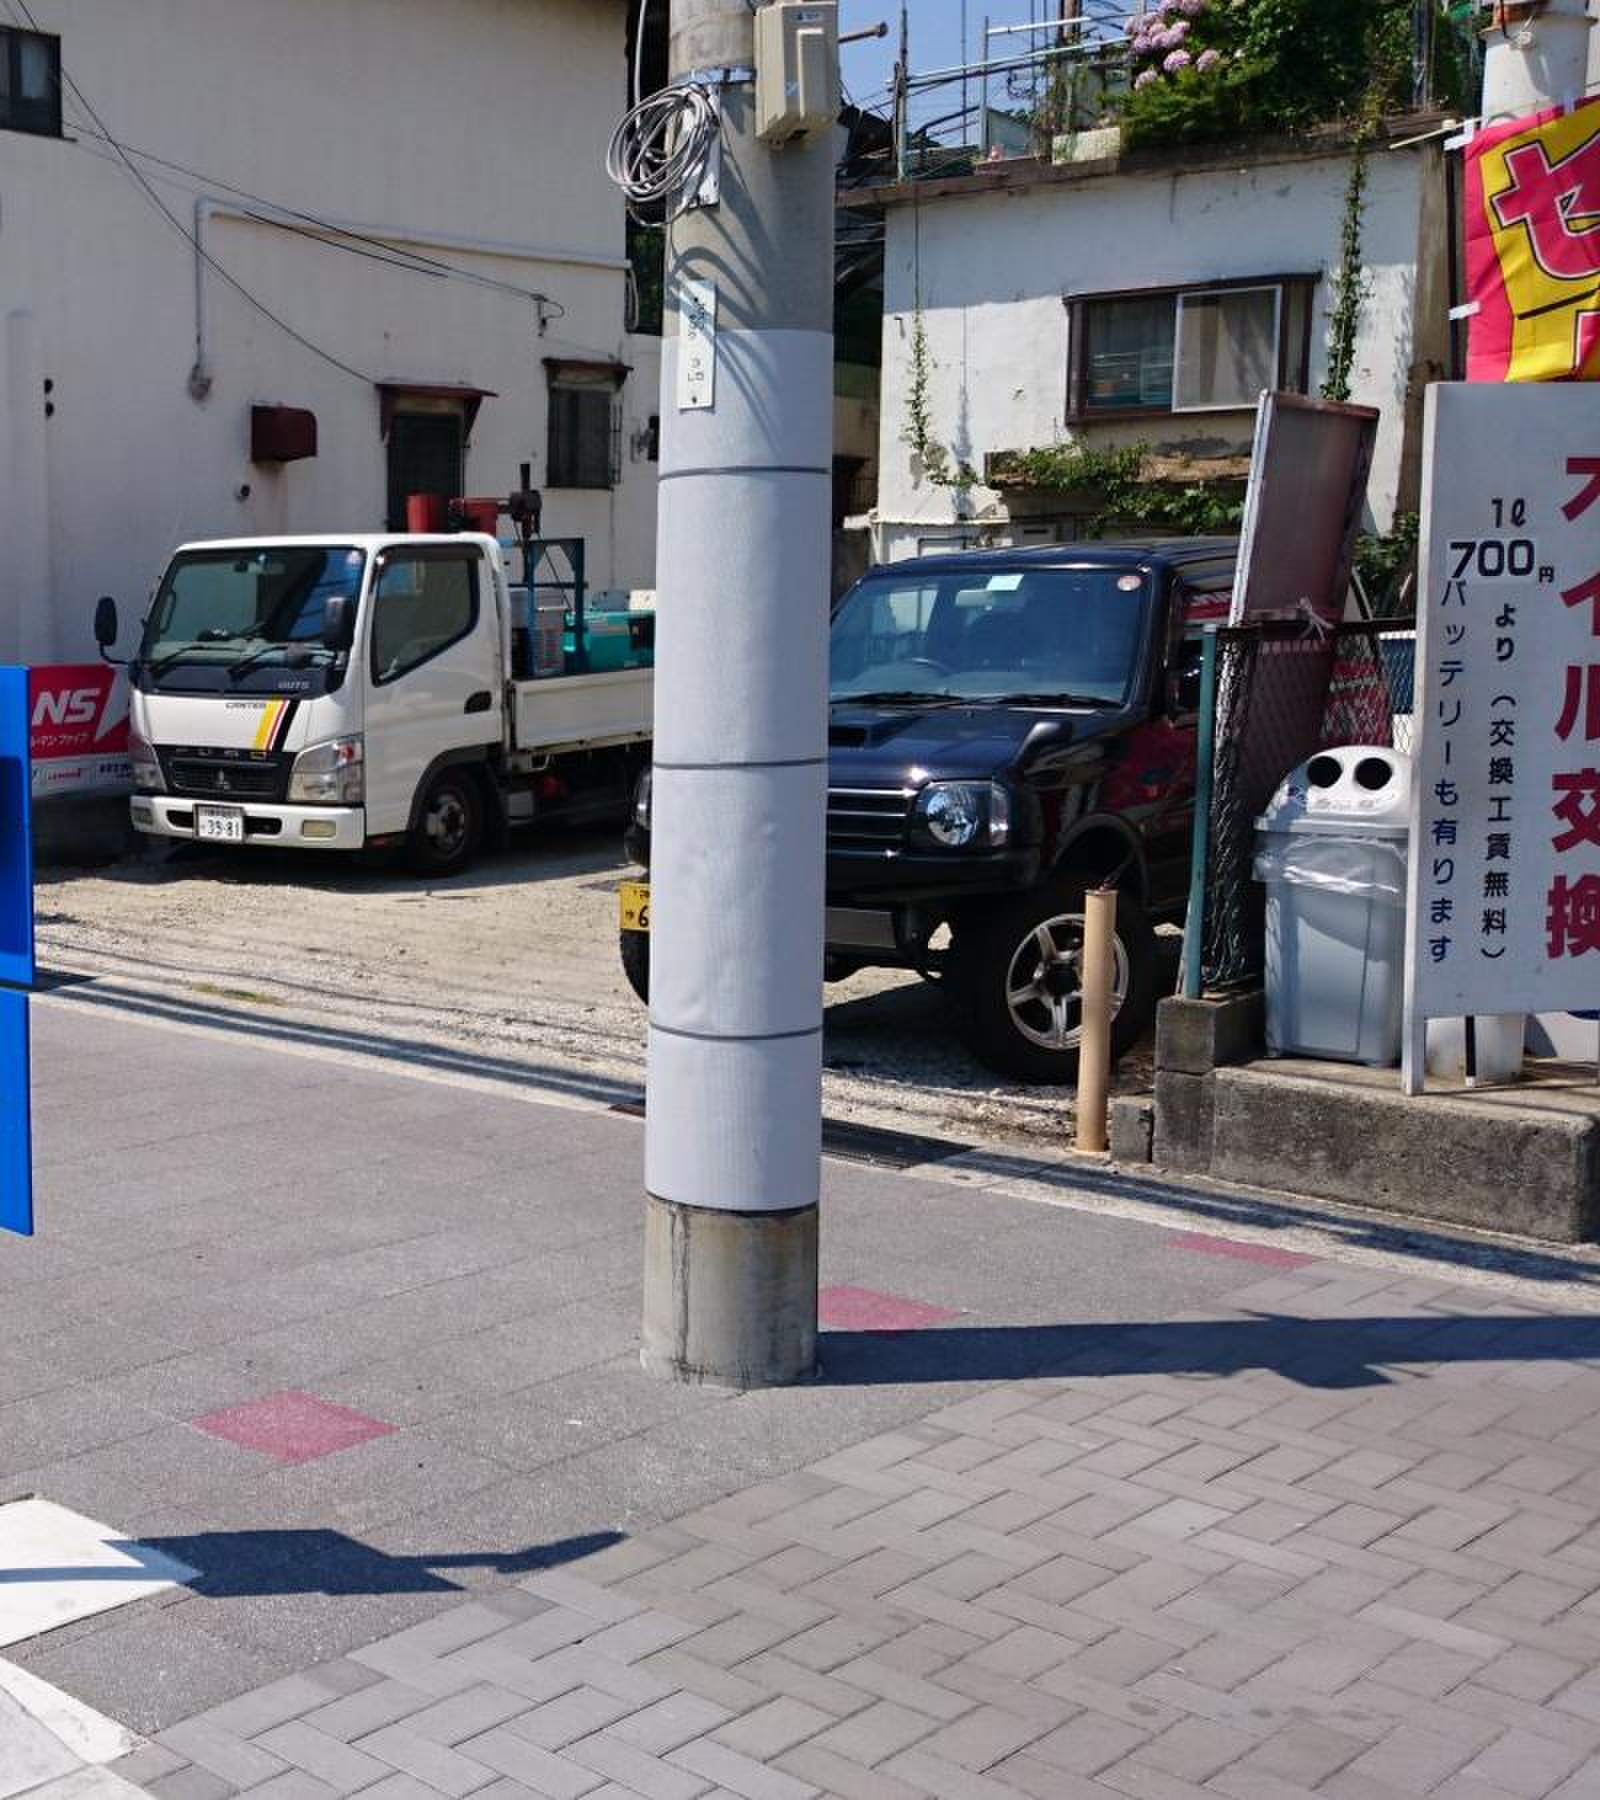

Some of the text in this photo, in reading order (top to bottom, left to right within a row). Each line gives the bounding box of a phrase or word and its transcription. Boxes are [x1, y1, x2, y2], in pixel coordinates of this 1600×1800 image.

[31, 686, 102, 728] NS
[1428, 580, 1467, 963] バッテリーも有ります
